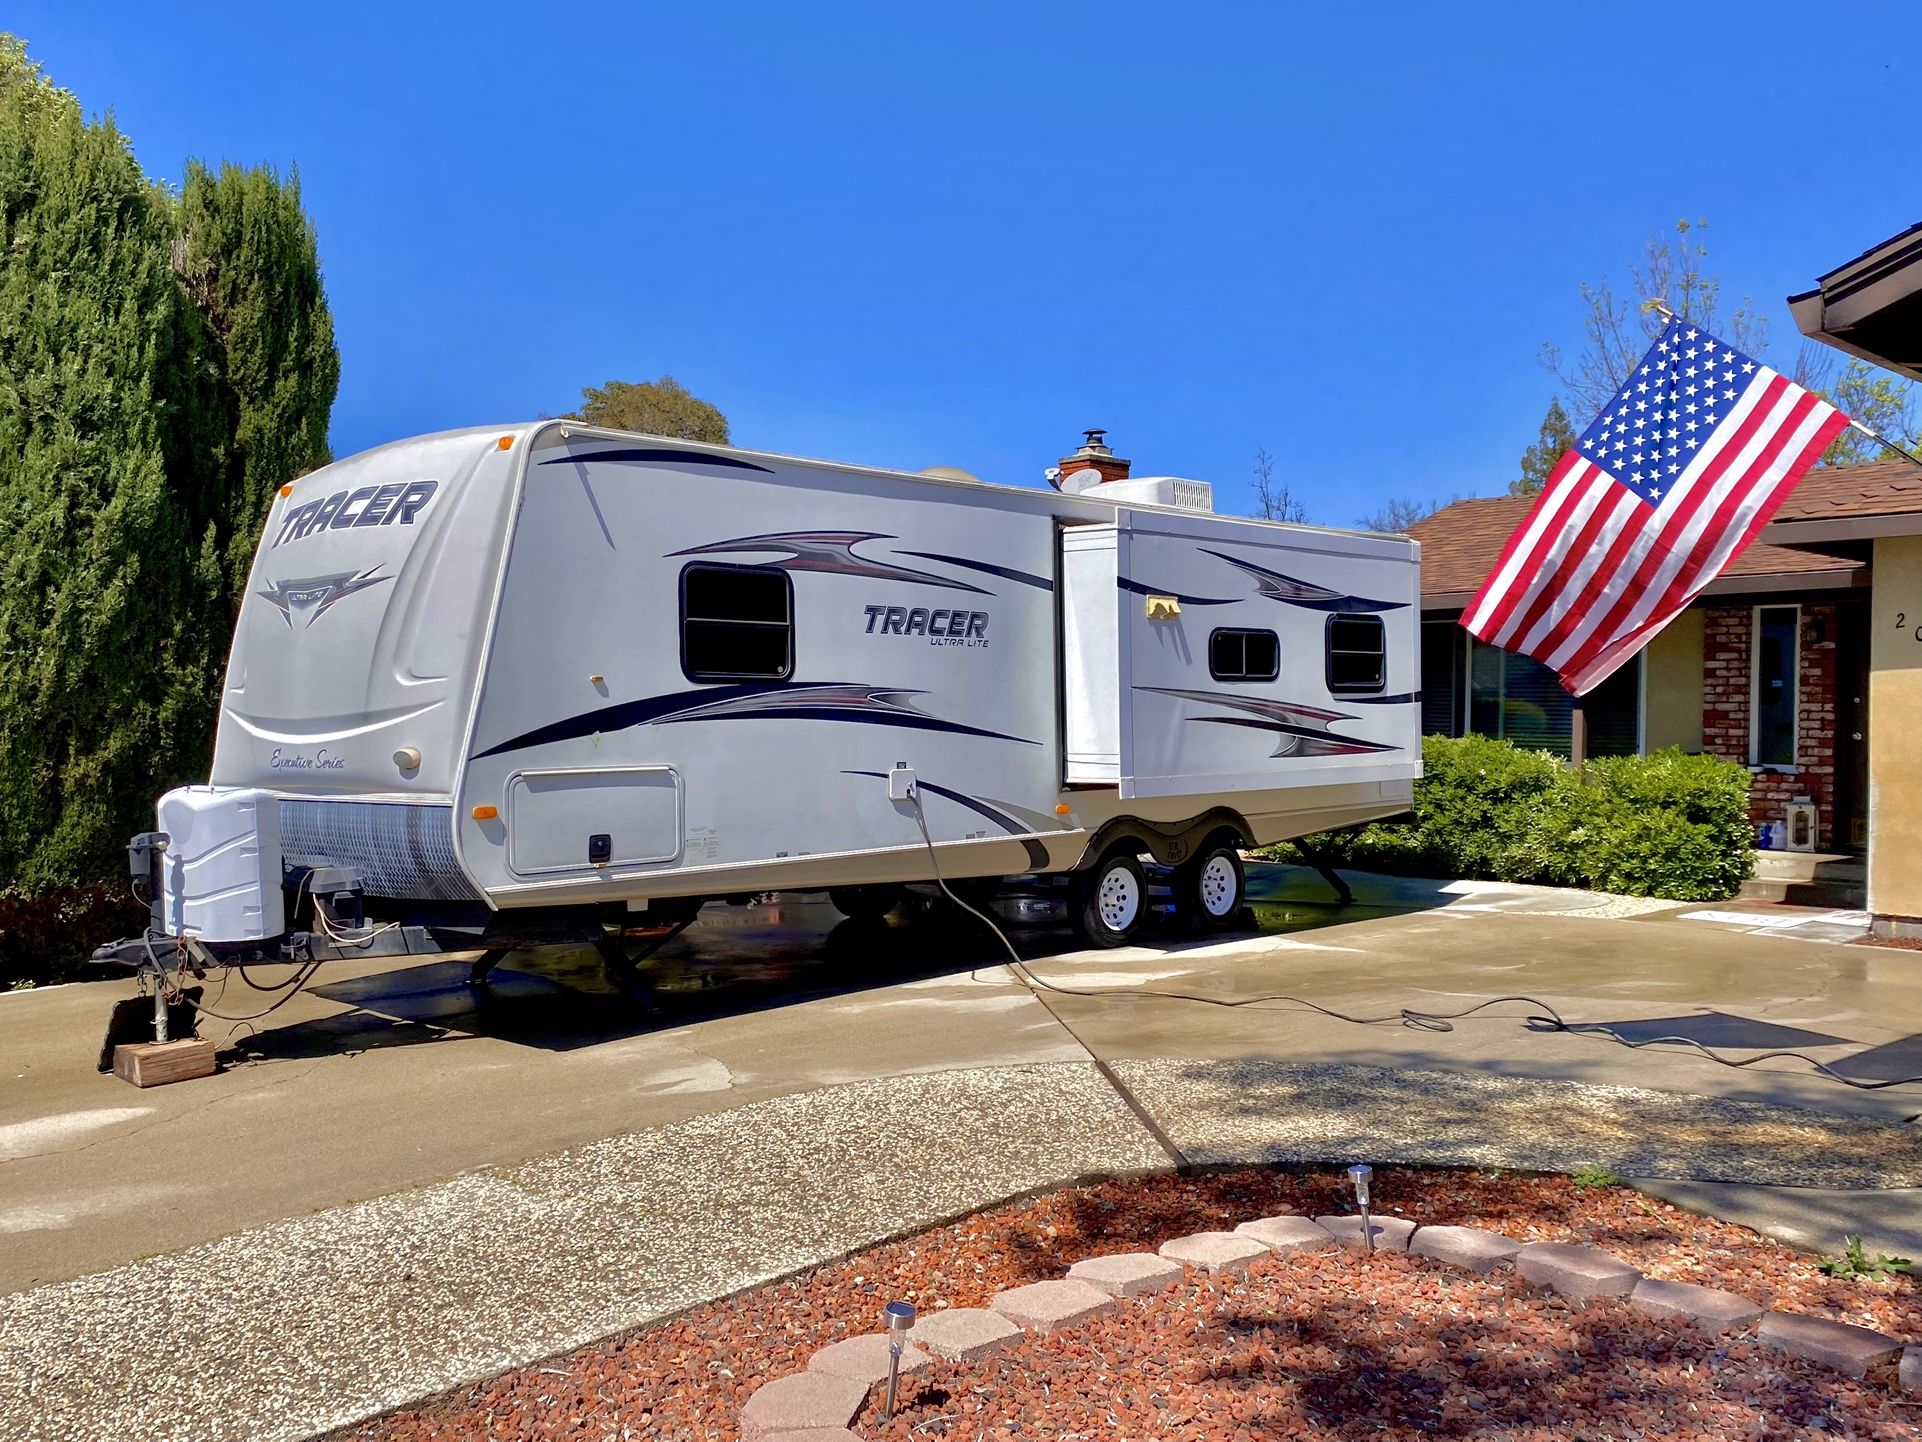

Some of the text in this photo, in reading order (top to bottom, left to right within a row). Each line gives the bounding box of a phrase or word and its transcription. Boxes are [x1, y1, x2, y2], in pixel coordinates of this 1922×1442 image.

[271, 480, 439, 550] TRACER
[864, 604, 989, 638] TRACER
[930, 638, 989, 648] ULTRA LITE
[270, 748, 345, 771] Executive Series
